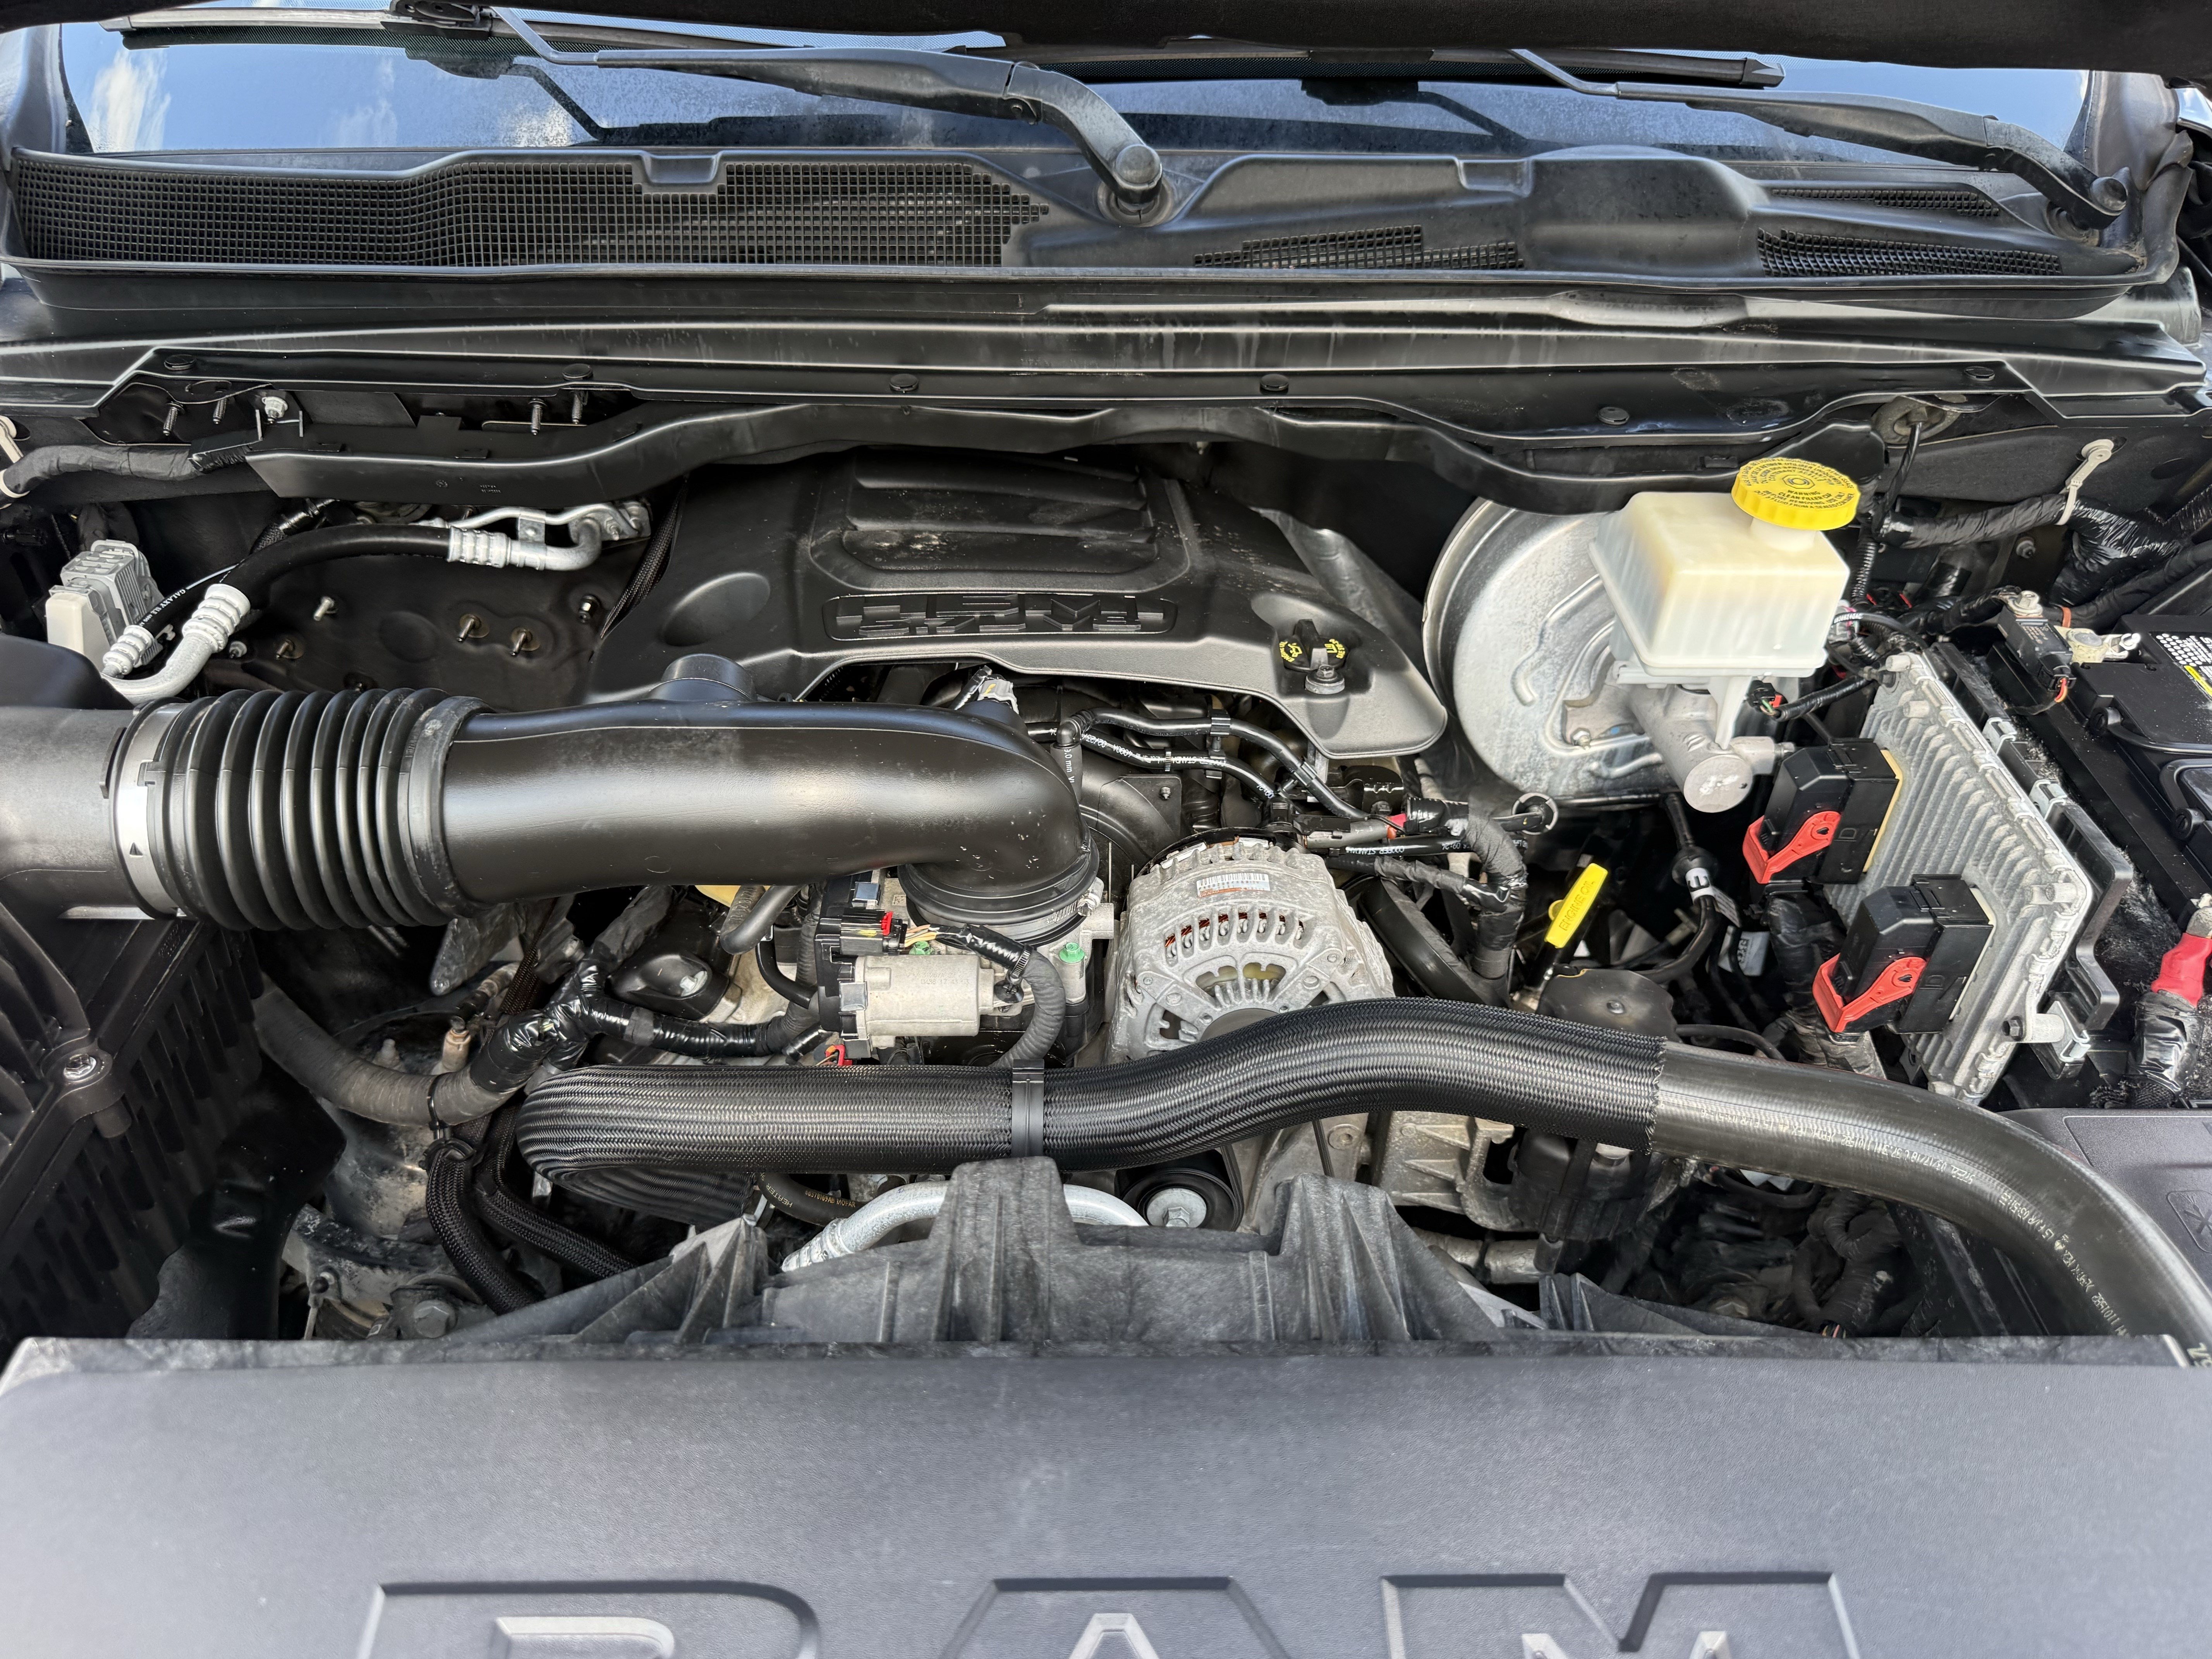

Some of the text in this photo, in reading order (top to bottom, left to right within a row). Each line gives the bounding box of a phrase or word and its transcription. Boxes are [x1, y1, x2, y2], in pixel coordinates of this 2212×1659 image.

[1778, 492, 1798, 500] CLEAN
[159, 589, 186, 609] GALAXY
[1063, 759, 1075, 773] mm
[1558, 877, 1595, 931] ENGINE OIL
[836, 1198, 856, 1208] MOPAR
